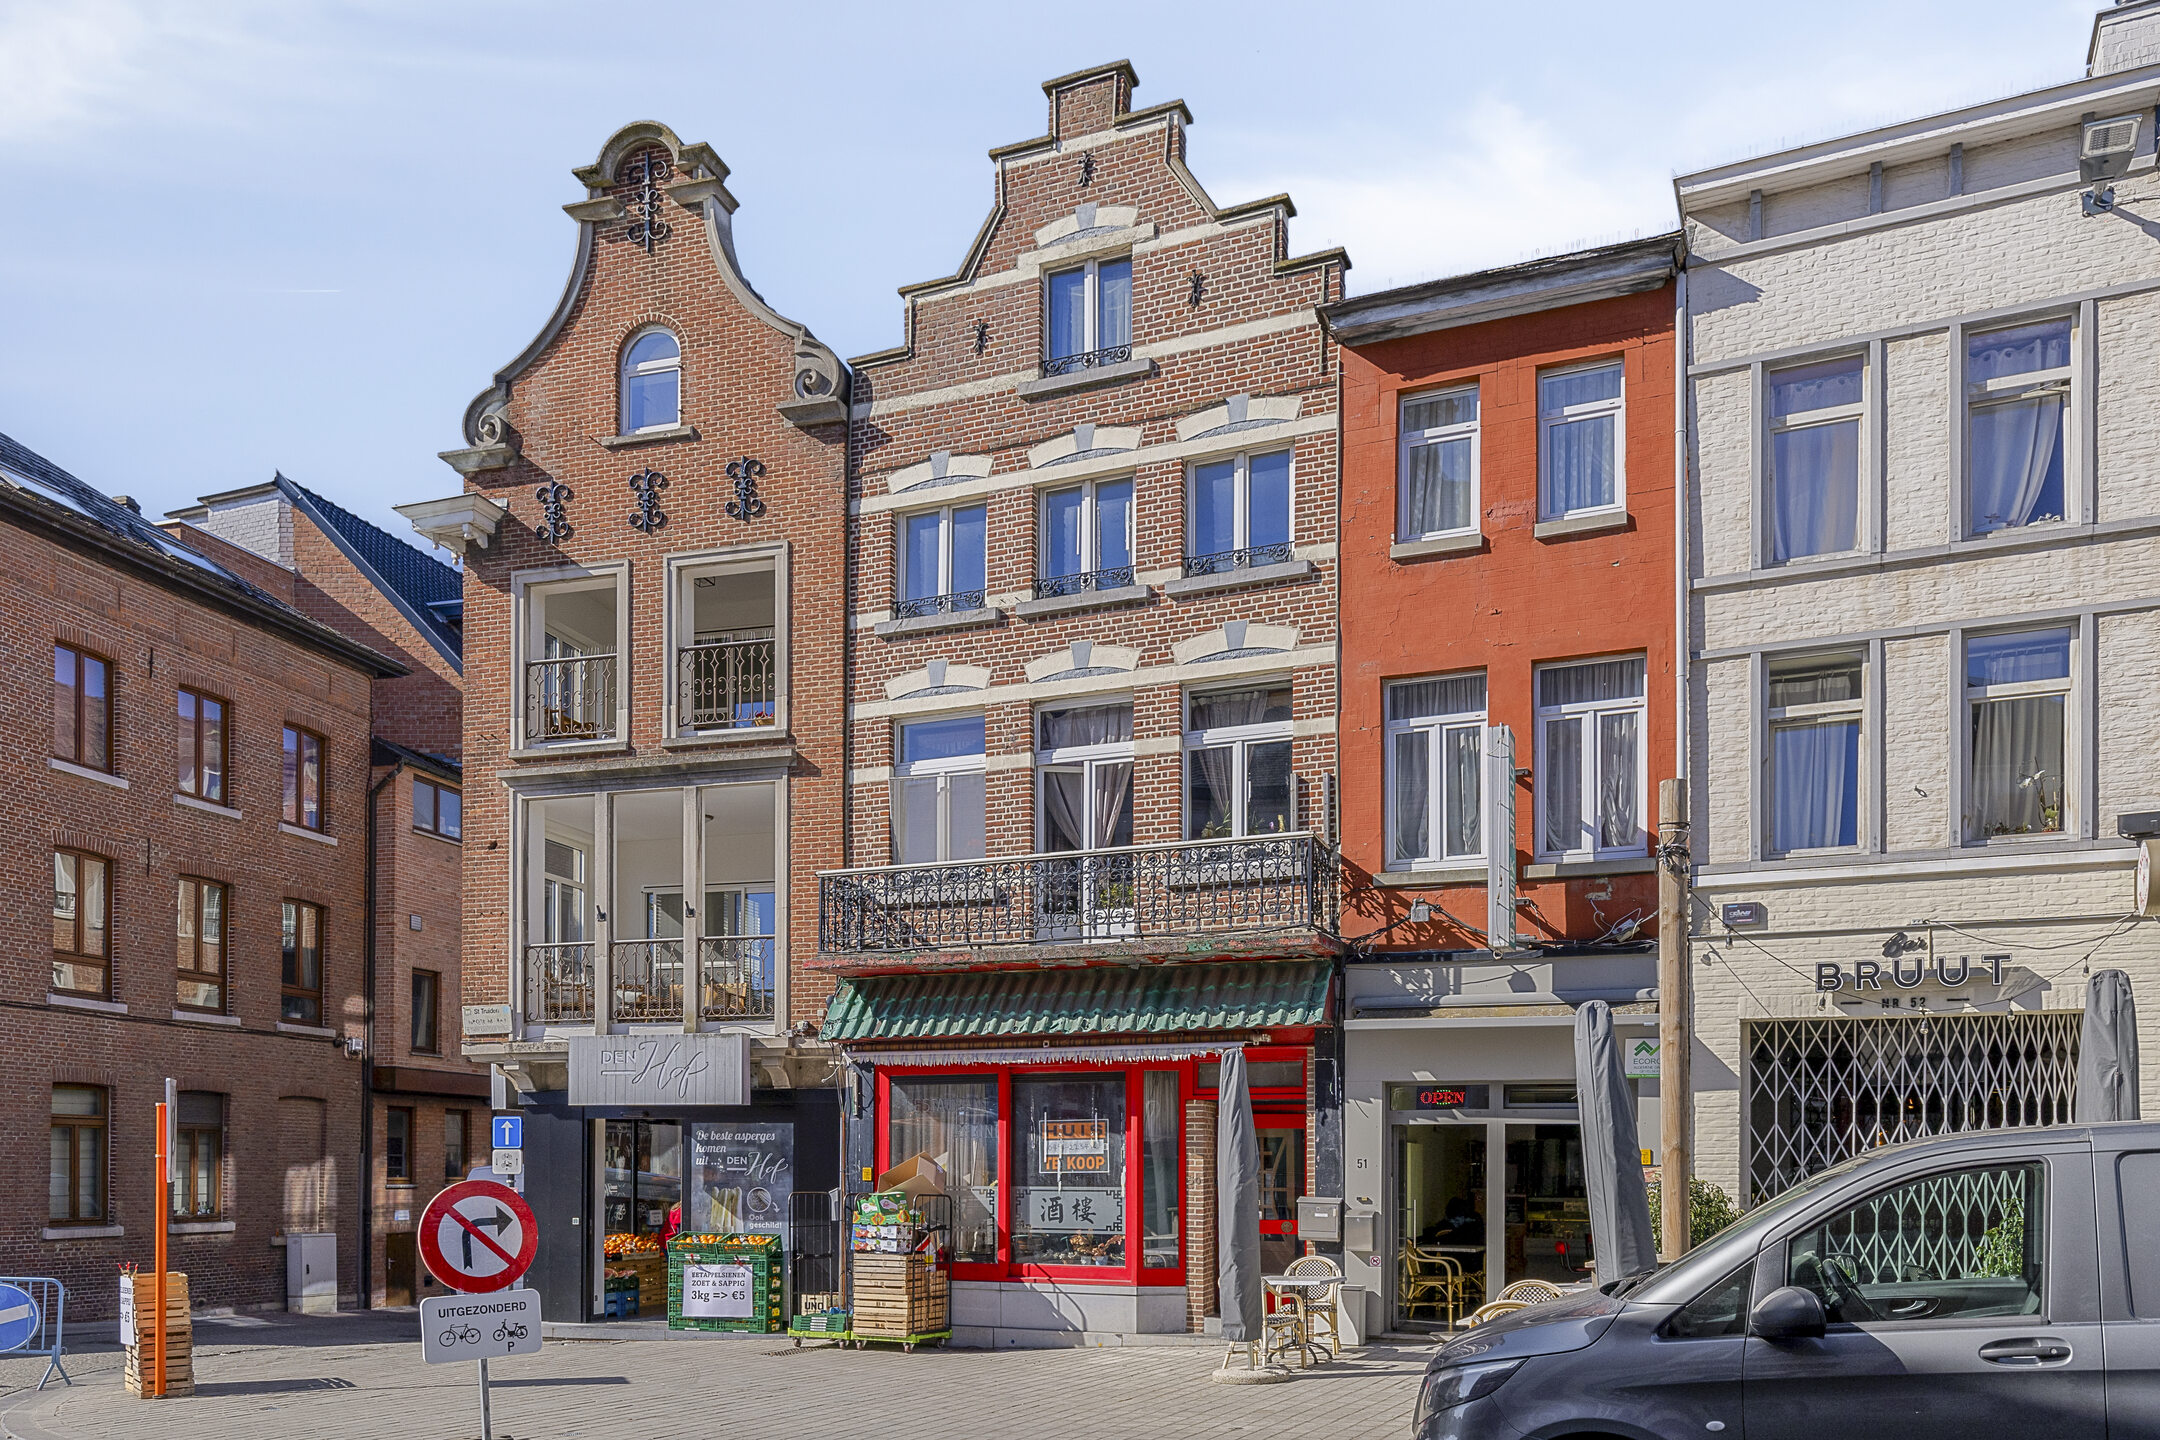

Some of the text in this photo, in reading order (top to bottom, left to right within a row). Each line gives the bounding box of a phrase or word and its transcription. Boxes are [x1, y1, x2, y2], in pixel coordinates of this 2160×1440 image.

[1881, 931, 1929, 958] Bar
[1815, 952, 2012, 993] BRUUT
[1881, 996, 1926, 1008] NR 52
[601, 1041, 709, 1098] DEN Hof
[1420, 1091, 1465, 1104] OPEN
[695, 1130, 776, 1144] De beste asperges
[1044, 1123, 1103, 1137] HUIS
[695, 1143, 727, 1153] komen
[695, 1155, 709, 1165] uit
[1046, 1156, 1105, 1170] TE KOOP
[1357, 1158, 1368, 1169] 51
[726, 1151, 788, 1184] DEN Hof
[1040, 1196, 1096, 1224] 酒樓
[749, 1222, 782, 1230] geschild!
[691, 1290, 745, 1303] 3kg => €5
[438, 1301, 527, 1318] UITGEZONDERD
[507, 1341, 515, 1352] P
